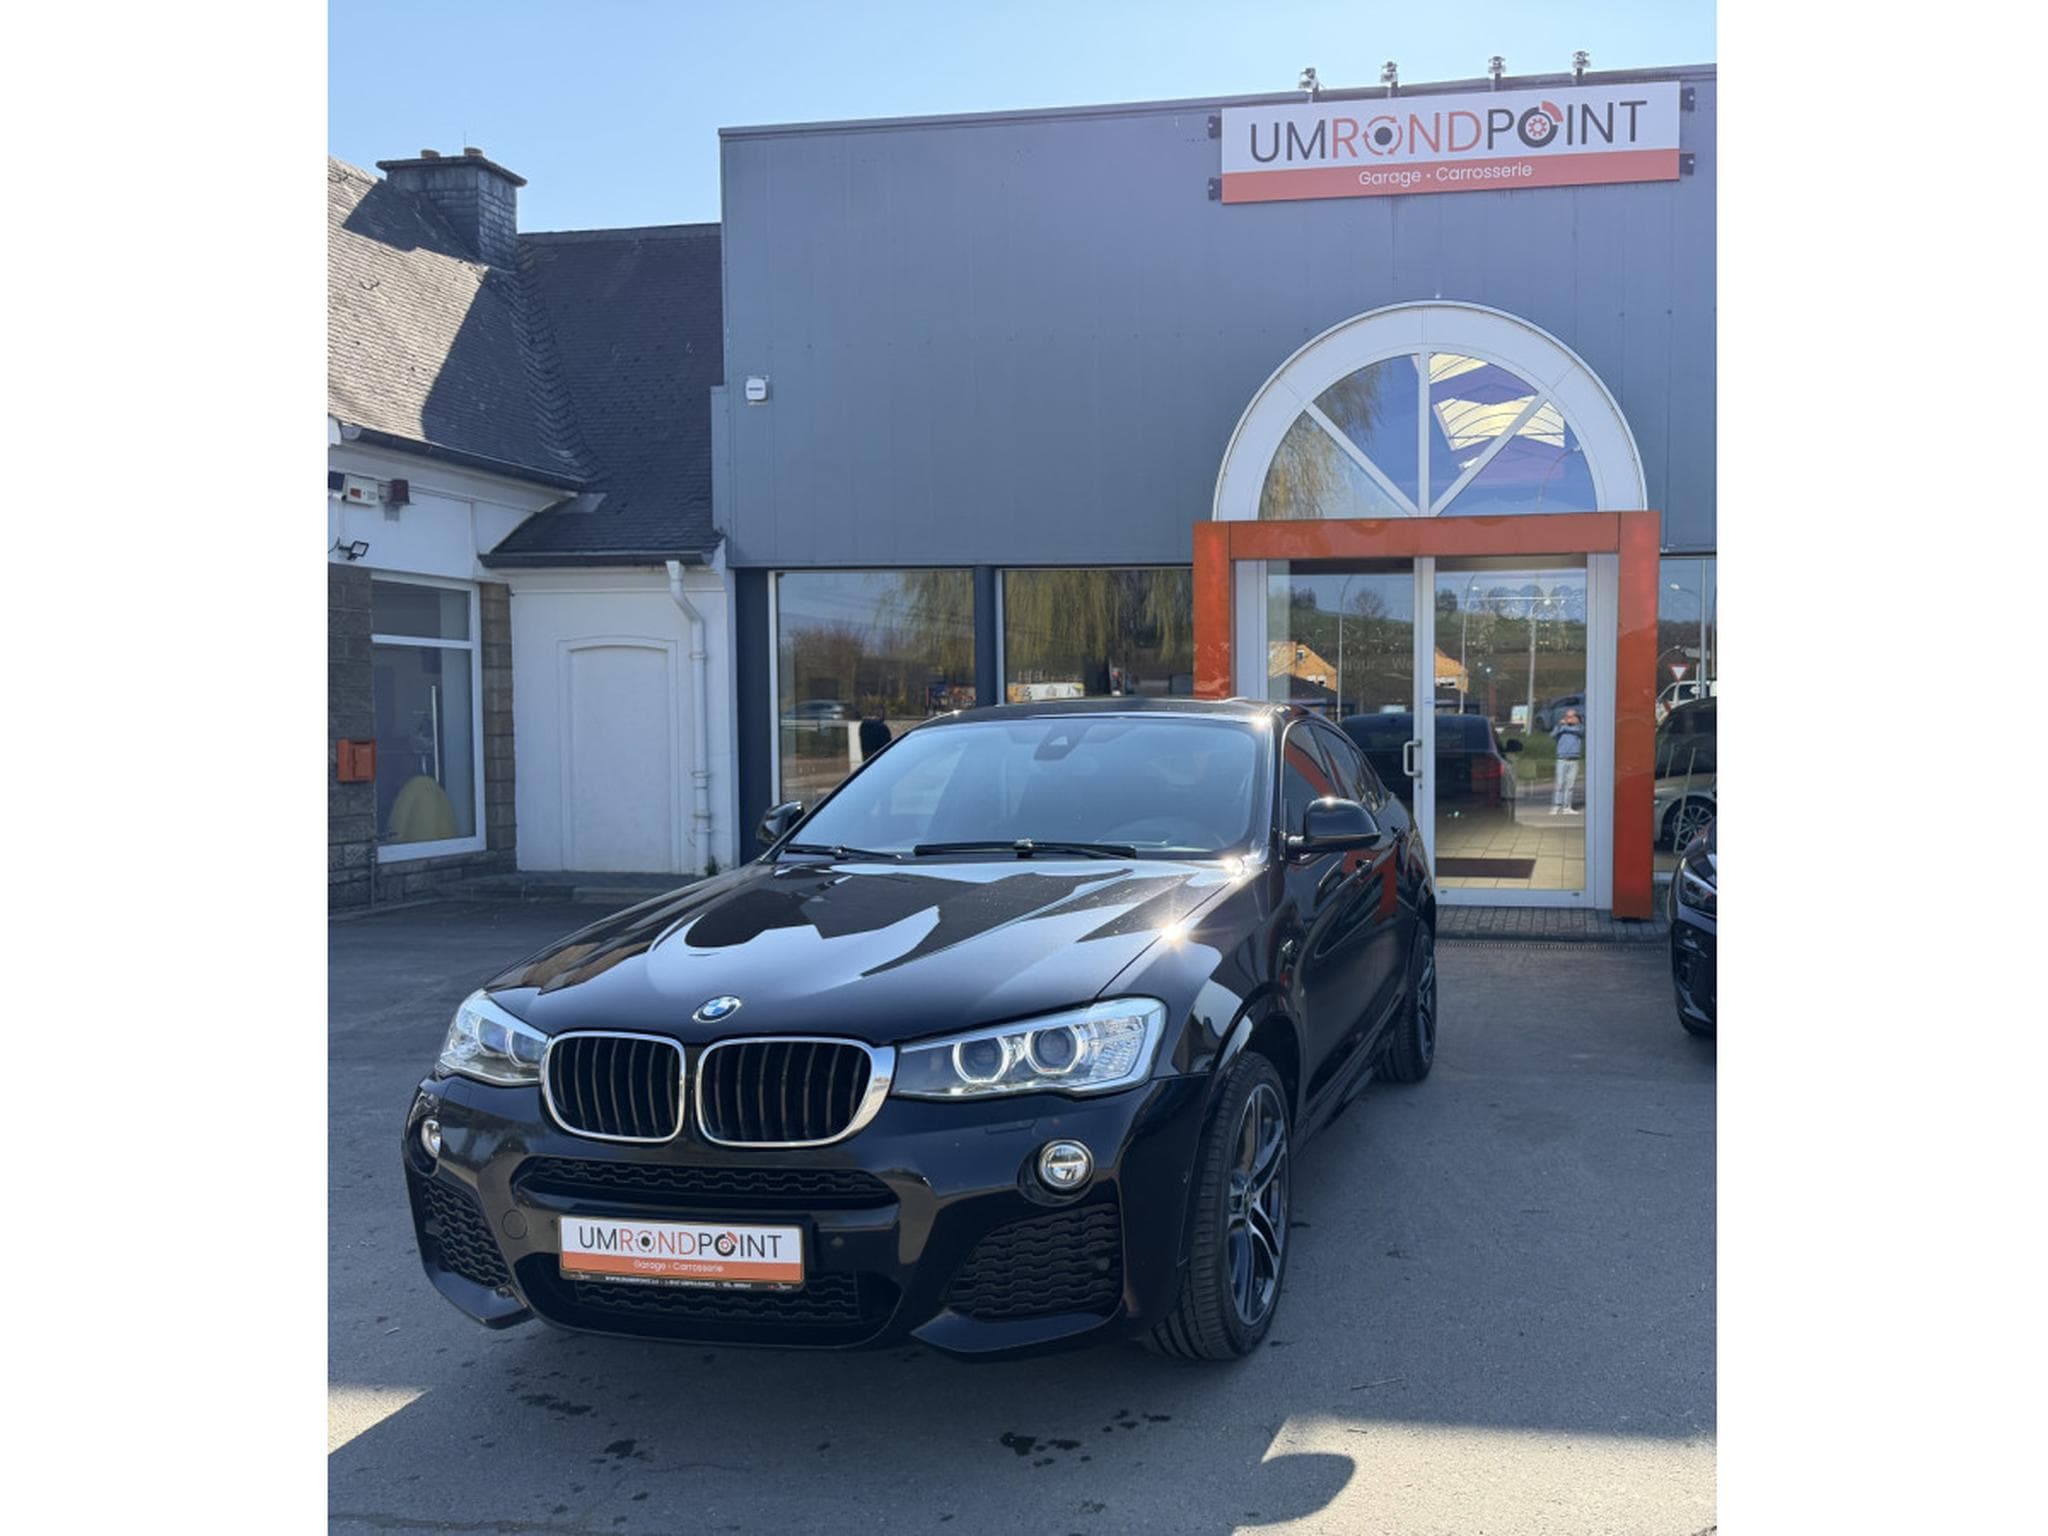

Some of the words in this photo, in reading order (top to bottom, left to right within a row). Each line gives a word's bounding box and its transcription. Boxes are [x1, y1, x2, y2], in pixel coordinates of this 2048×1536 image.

[1250, 100, 1648, 163] UMRONDPOINT
[1358, 170, 1421, 186] Garage
[1436, 163, 1533, 181] Carrosserie
[579, 1226, 782, 1258] UMRONDPOINT
[633, 1259, 667, 1272] Garage
